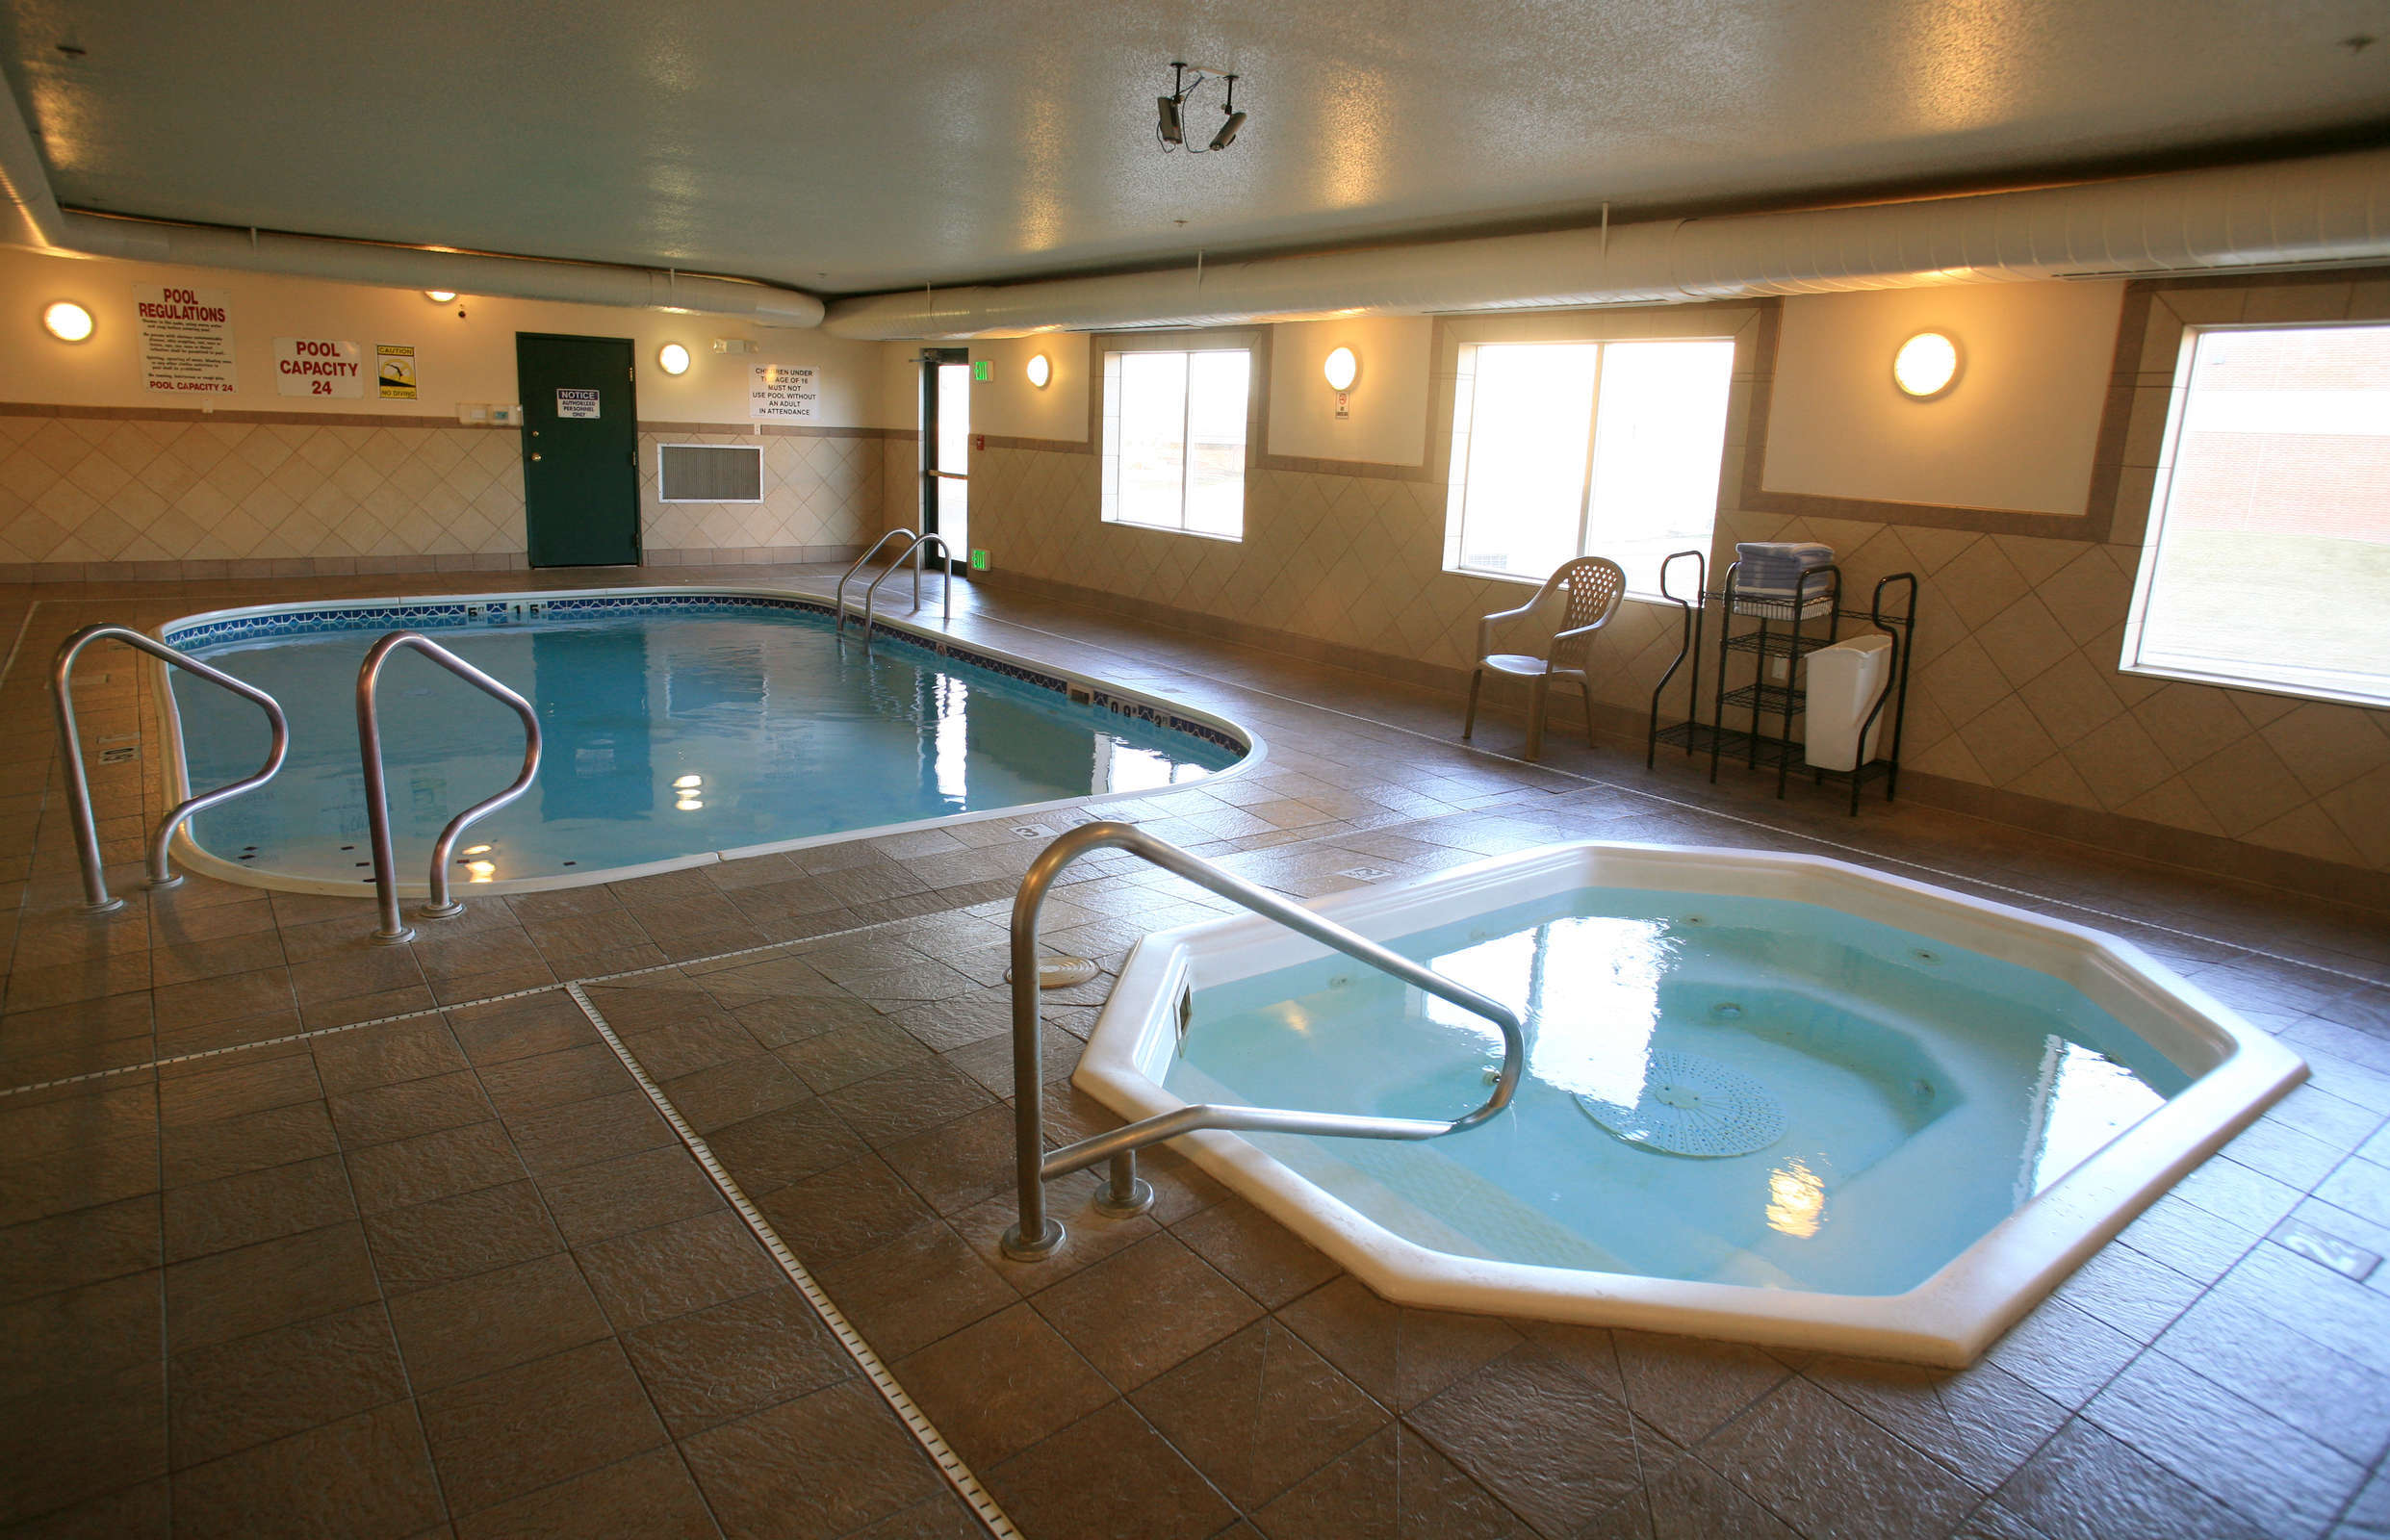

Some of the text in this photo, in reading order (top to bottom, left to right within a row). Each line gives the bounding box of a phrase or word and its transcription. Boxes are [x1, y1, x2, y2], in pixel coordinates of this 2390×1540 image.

[164, 288, 198, 305] POOL
[139, 302, 226, 322] REGULATIONS
[296, 341, 341, 357] POOL
[280, 360, 358, 377] CAPACITY
[150, 381, 174, 390] POOL
[177, 382, 219, 391] CAPACITY
[312, 380, 332, 395] 24
[561, 391, 596, 399] NOTICE
